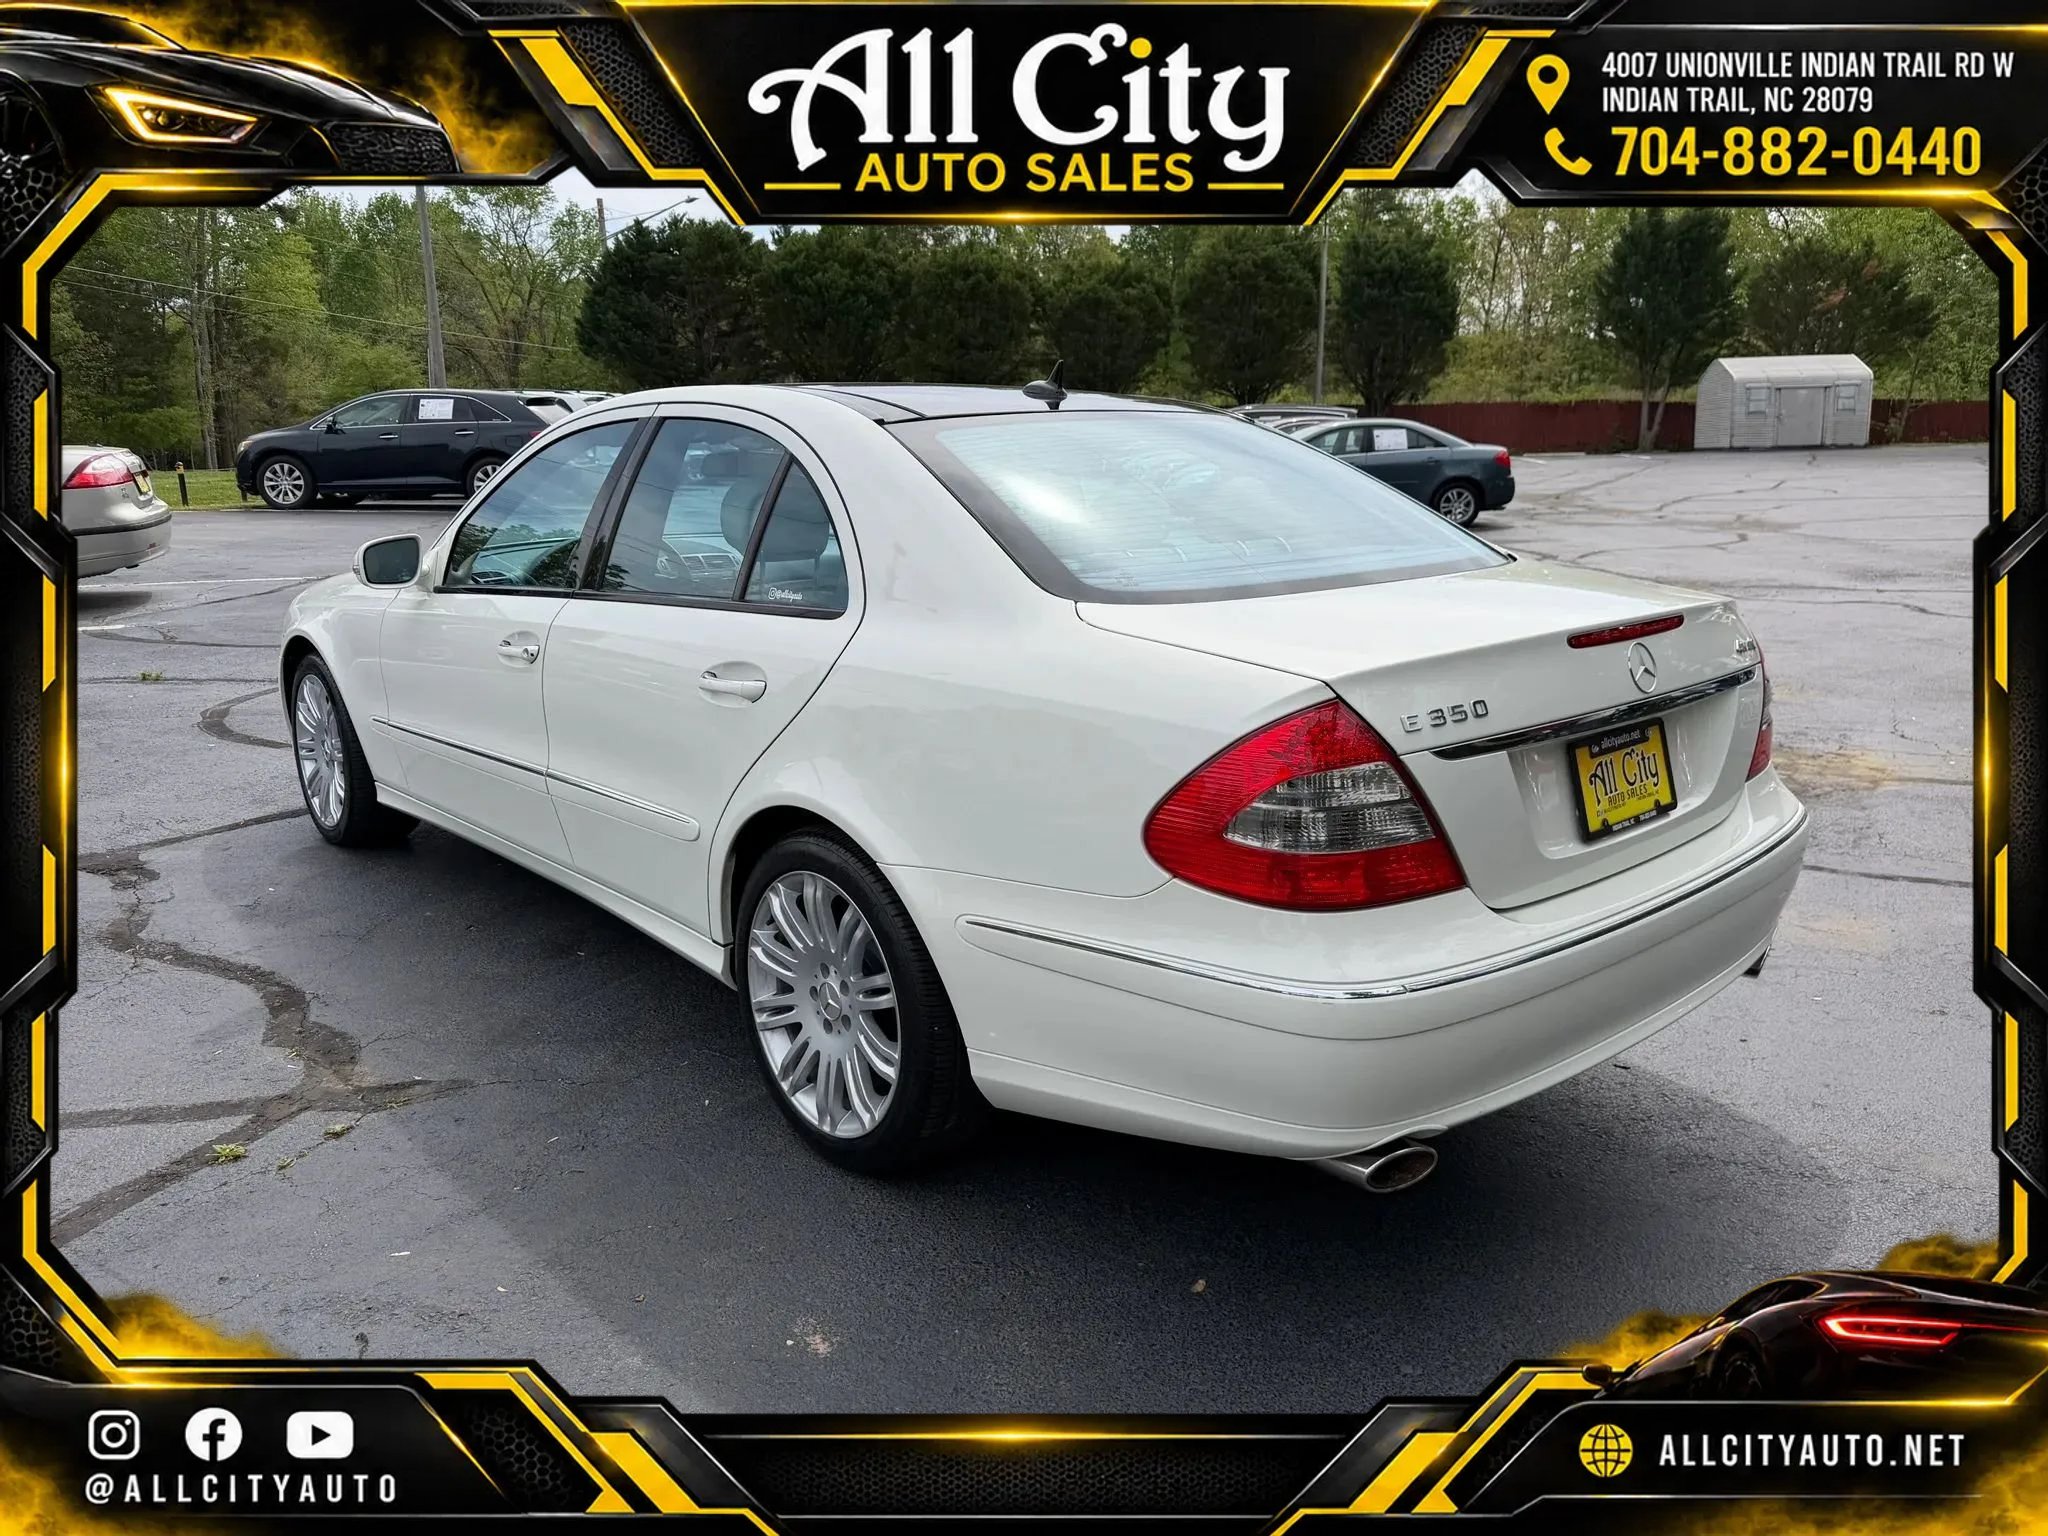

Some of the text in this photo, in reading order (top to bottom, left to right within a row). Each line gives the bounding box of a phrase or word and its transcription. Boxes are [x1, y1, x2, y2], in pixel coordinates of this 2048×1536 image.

[1400, 699, 1489, 733] E 350
[1589, 748, 1660, 807] All City
[1607, 791, 1625, 807] AUTO
[1627, 783, 1648, 800] SALES
